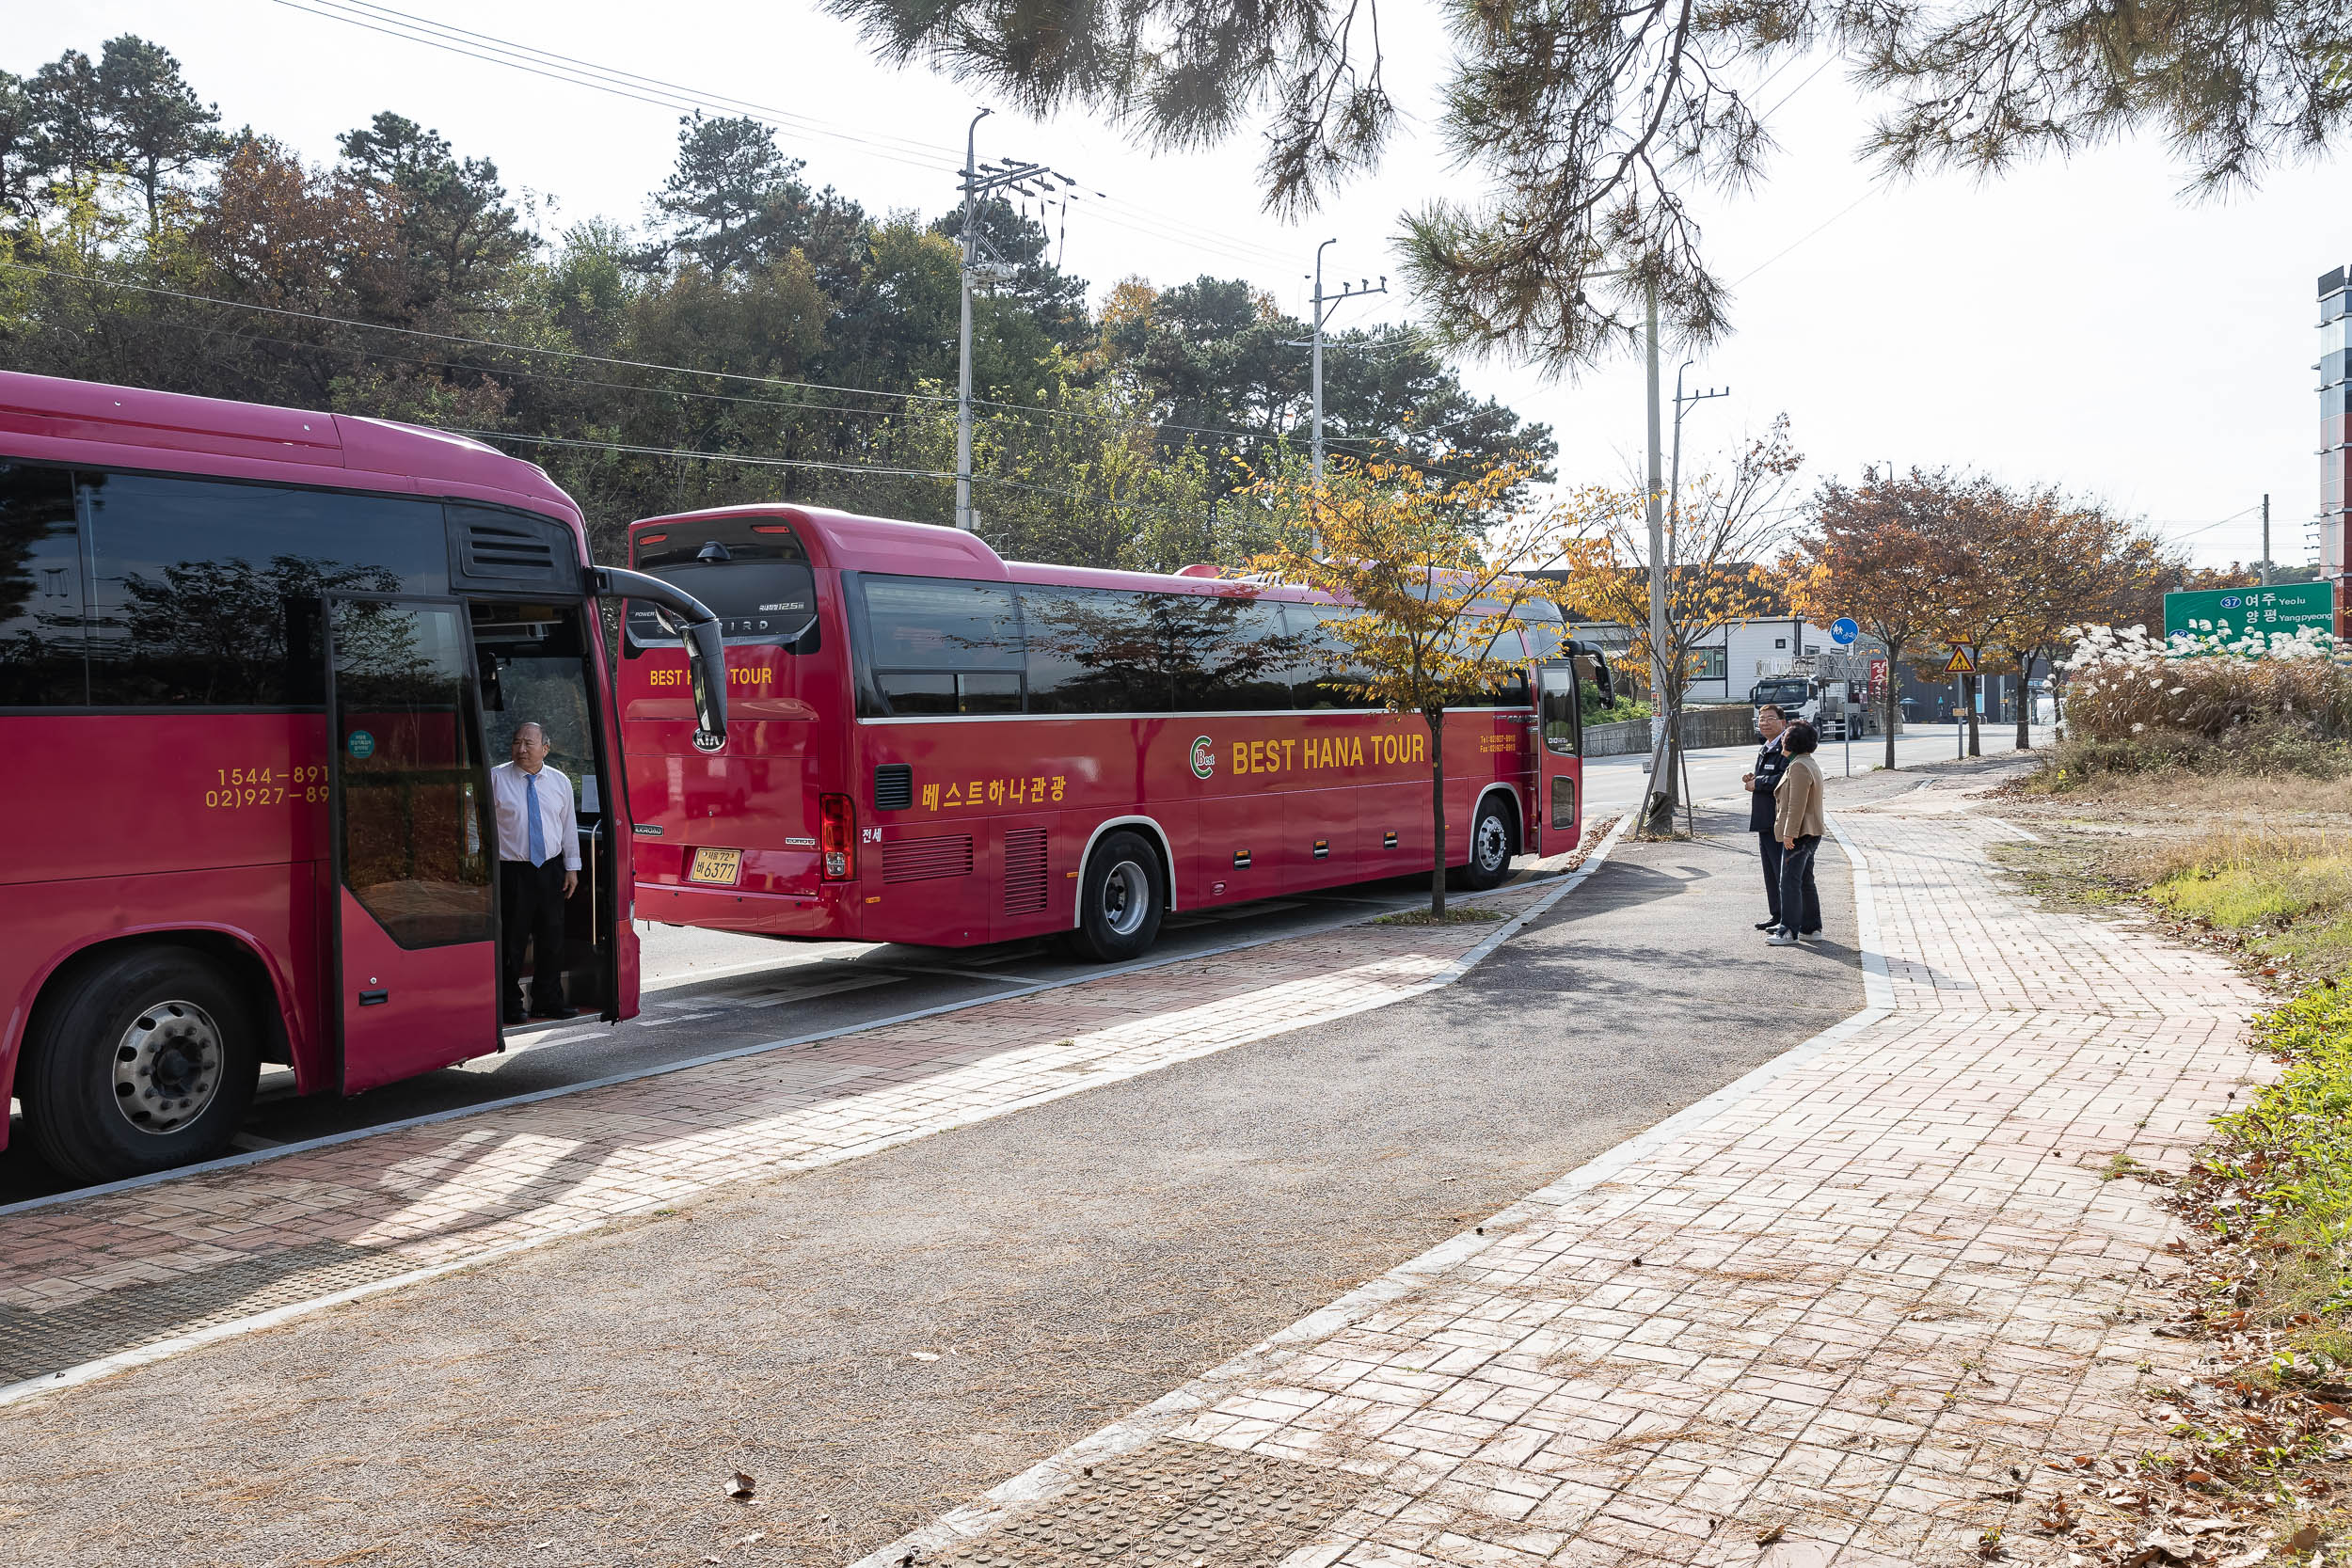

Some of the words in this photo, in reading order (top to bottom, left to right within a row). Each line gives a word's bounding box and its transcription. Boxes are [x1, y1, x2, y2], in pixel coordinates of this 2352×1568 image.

[2225, 598, 2237, 607] 37
[2246, 593, 2277, 607] 여주
[2246, 609, 2277, 624] 양평
[2279, 613, 2333, 623] Yangpyeong
[650, 670, 683, 686] BEST
[730, 668, 772, 685] TOUR
[697, 733, 721, 746] KIA
[1232, 739, 1295, 775] BEST
[1303, 736, 1364, 769] HANA
[1370, 734, 1424, 765] TOUR
[922, 775, 1066, 812] 베스트하나관광
[862, 827, 882, 844] 전세
[720, 853, 730, 862] 72
